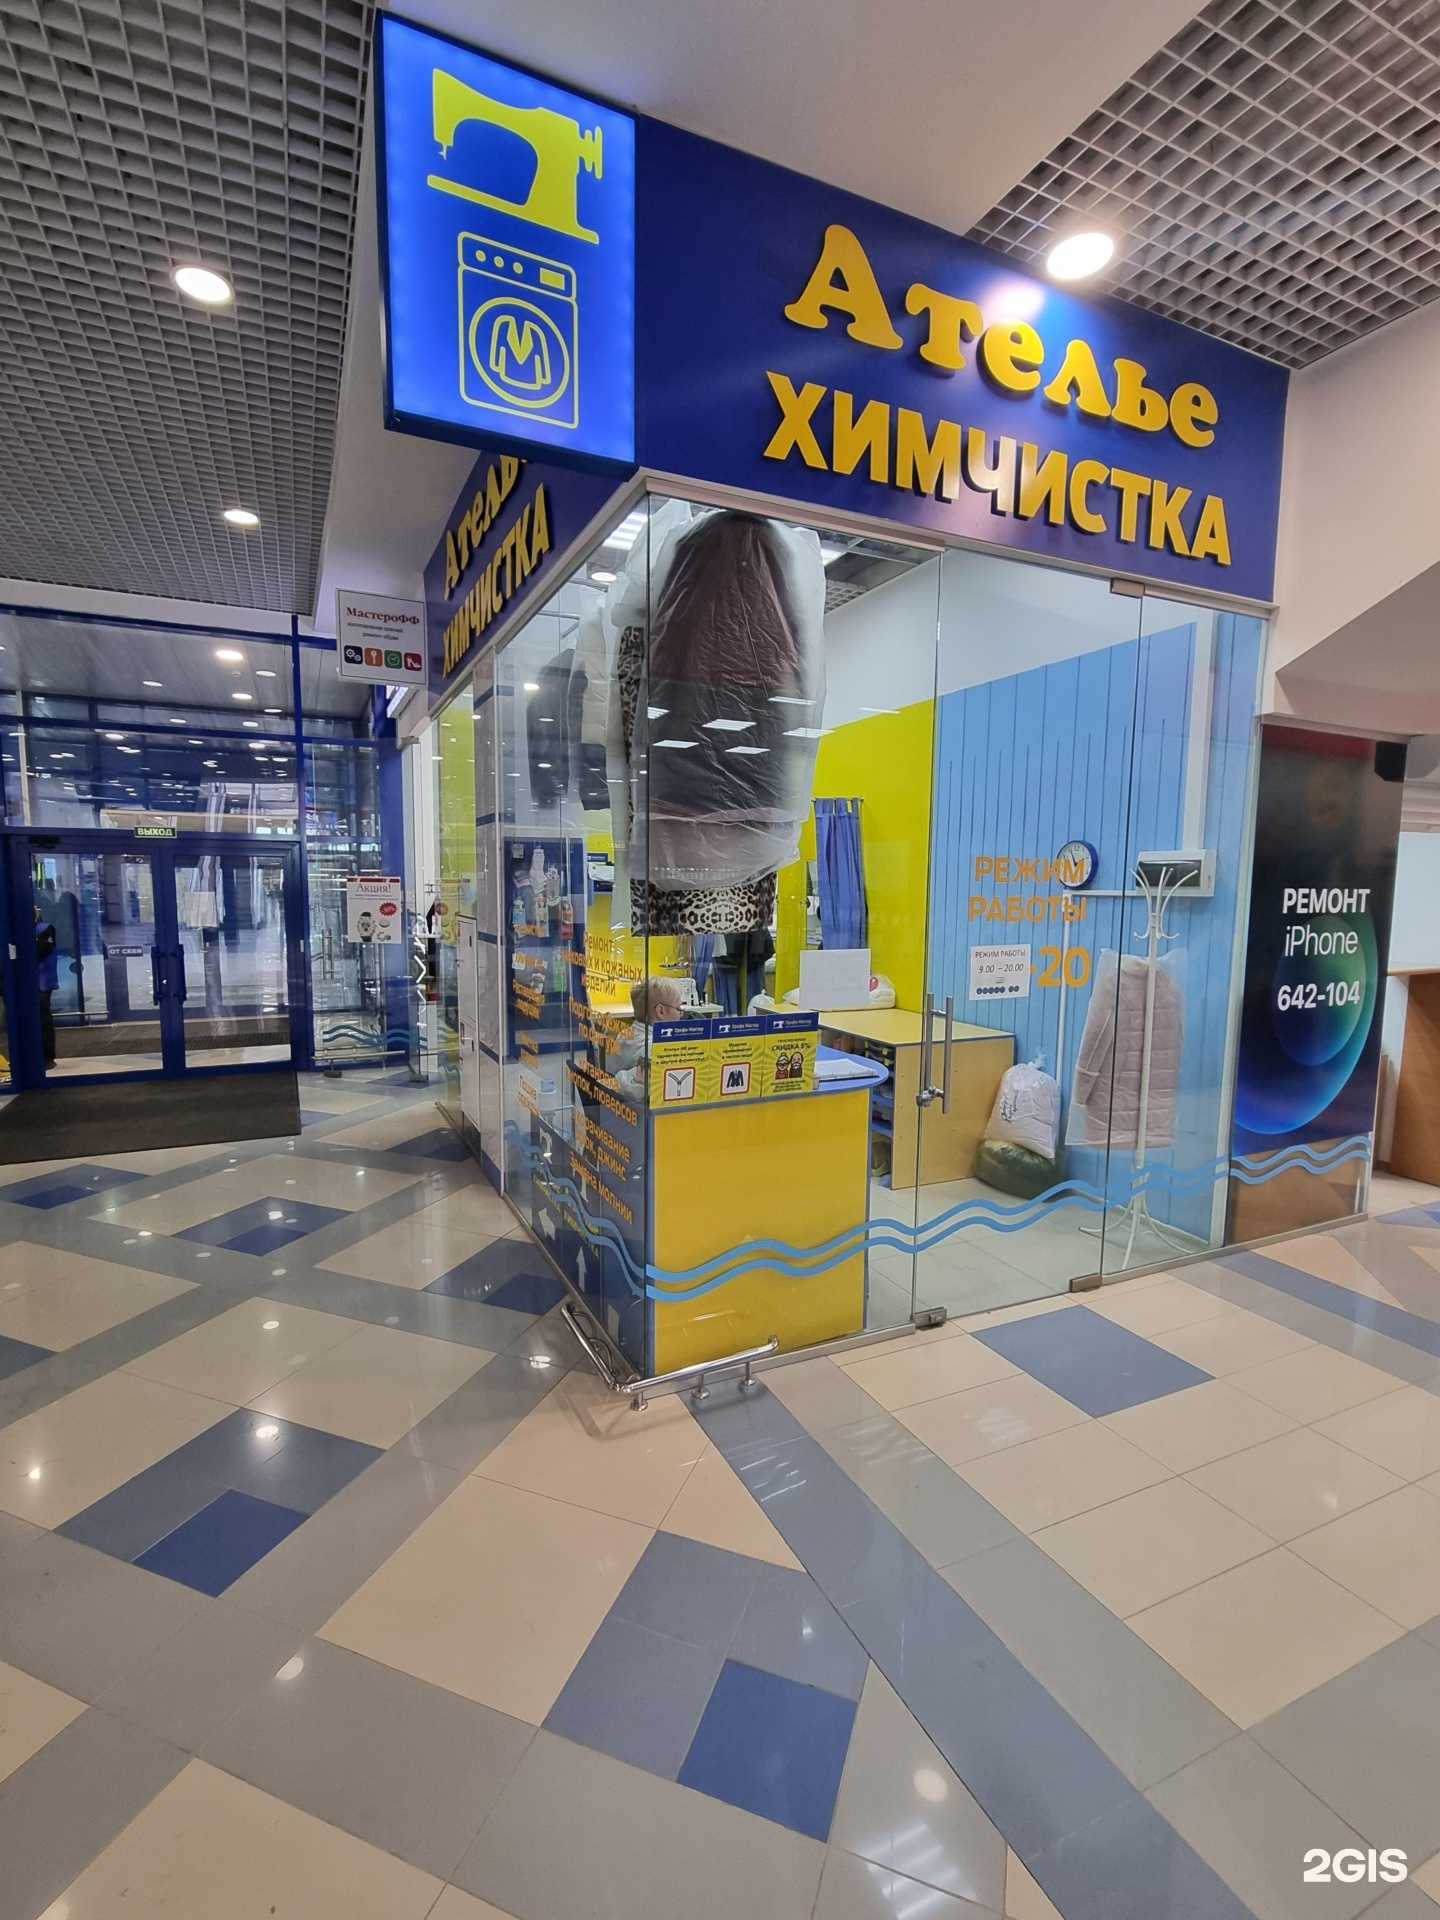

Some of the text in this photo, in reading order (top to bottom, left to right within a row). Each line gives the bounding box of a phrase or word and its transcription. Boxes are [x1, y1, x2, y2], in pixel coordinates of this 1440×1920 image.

[784, 224, 1220, 447] Ателье
[763, 370, 1232, 568] ХИМЧИСТКА
[444, 454, 527, 600] Атель
[442, 482, 550, 679] ХИМЧИСТКА
[137, 828, 173, 836] ВЫХОД
[975, 856, 1085, 884] РЕЖИМ
[968, 896, 1088, 924] РАБОТЫ
[1282, 888, 1371, 914] РЕМОНТ
[1284, 924, 1358, 957] iPhone
[602, 960, 642, 982] кожаных
[1277, 980, 1360, 1011] 642-104
